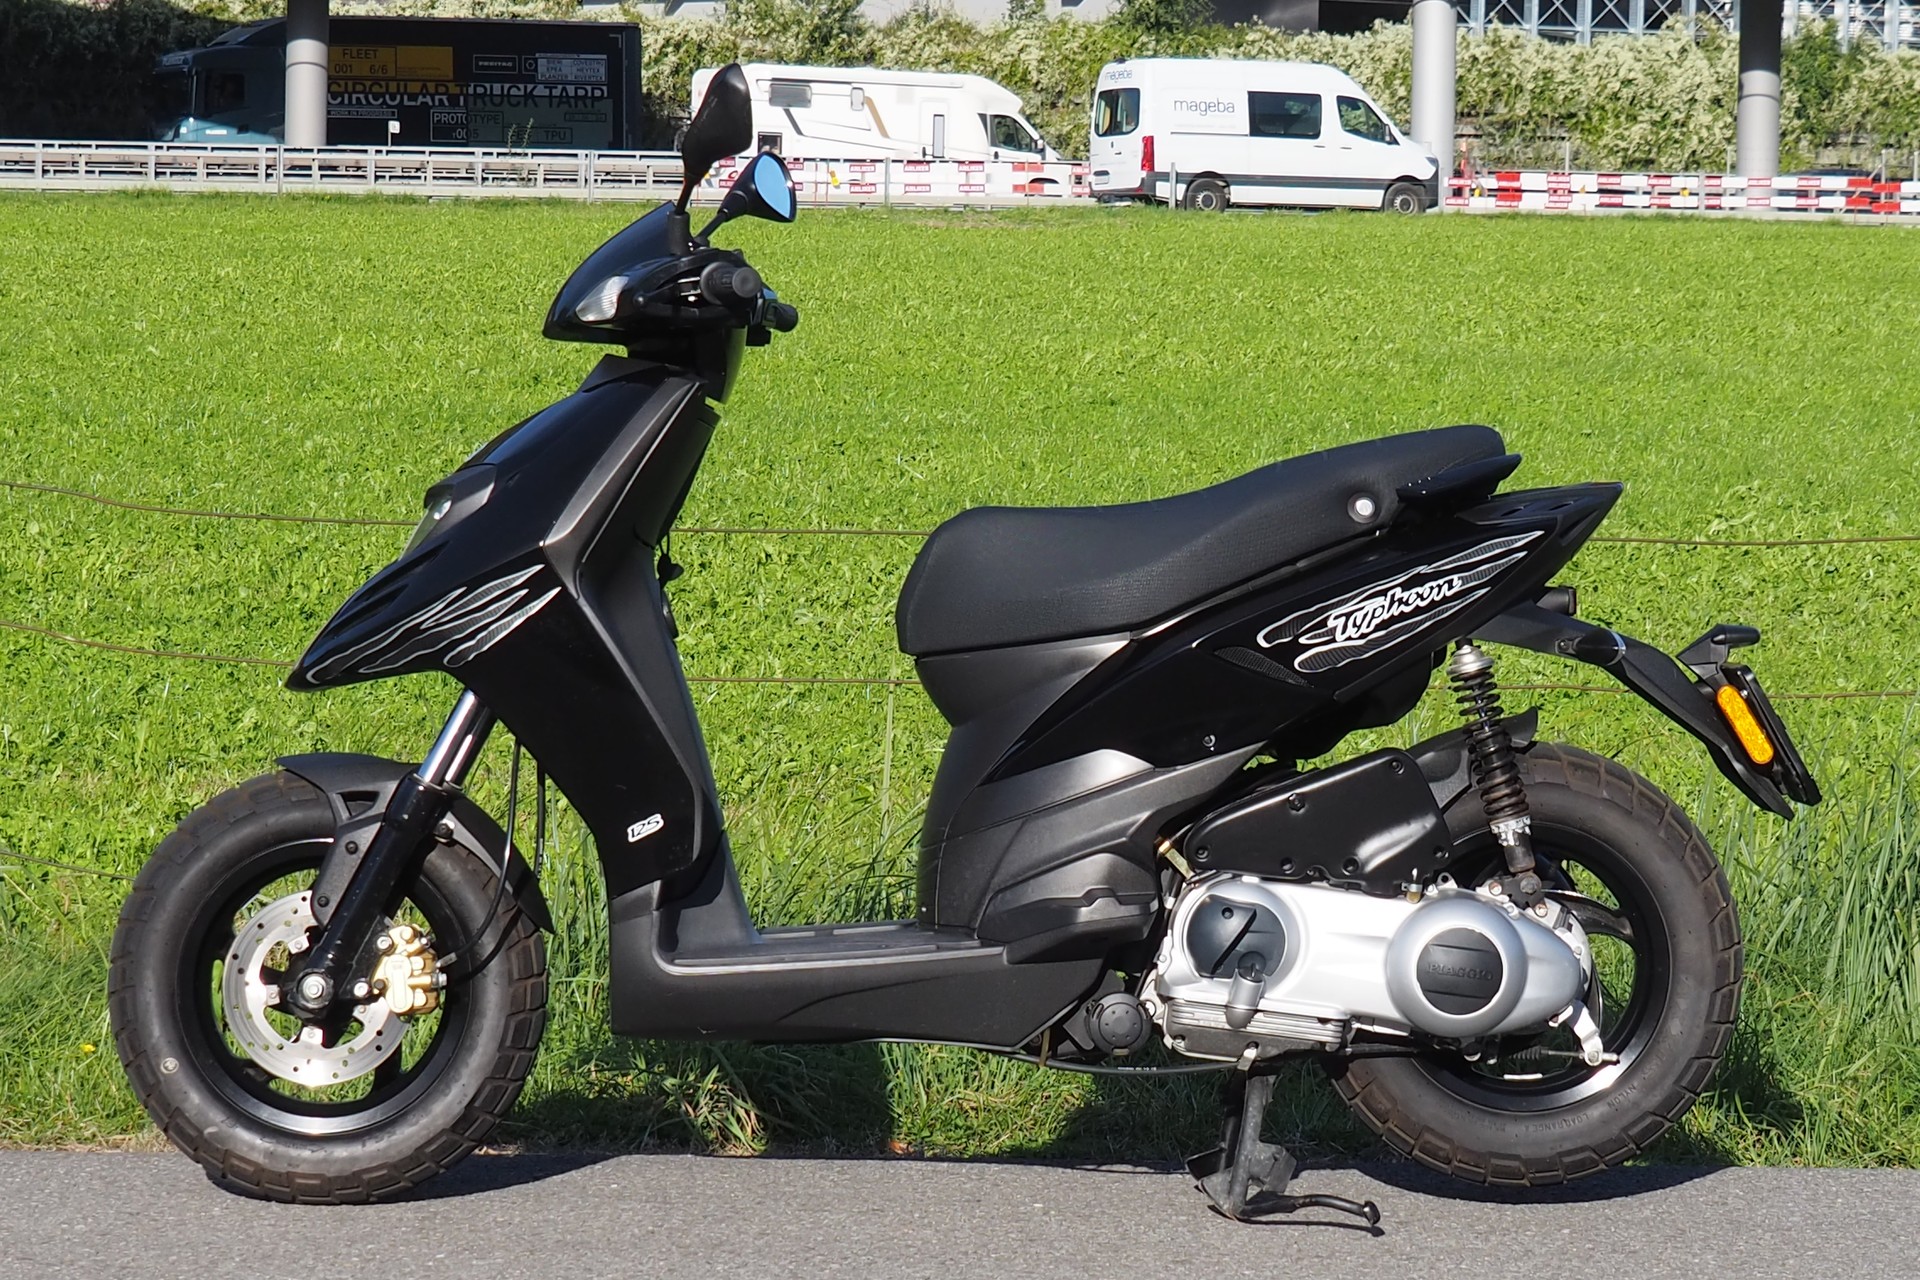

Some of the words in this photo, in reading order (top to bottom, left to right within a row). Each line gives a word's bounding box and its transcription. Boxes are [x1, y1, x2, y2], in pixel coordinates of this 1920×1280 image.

[342, 48, 379, 60] FLEET
[333, 63, 353, 75] 001
[369, 64, 389, 75] 6/6
[1103, 67, 1133, 84] mageba
[327, 81, 450, 107] CIRCULAR
[455, 83, 539, 108] TRUCK
[543, 85, 606, 109] TARP
[1173, 97, 1235, 117] mageba
[433, 112, 501, 125] PROTOTYPE
[543, 129, 567, 141] TPU
[1326, 574, 1462, 642] Typhoon
[629, 814, 662, 841] 125
[1428, 962, 1494, 981] PIAGGIO
